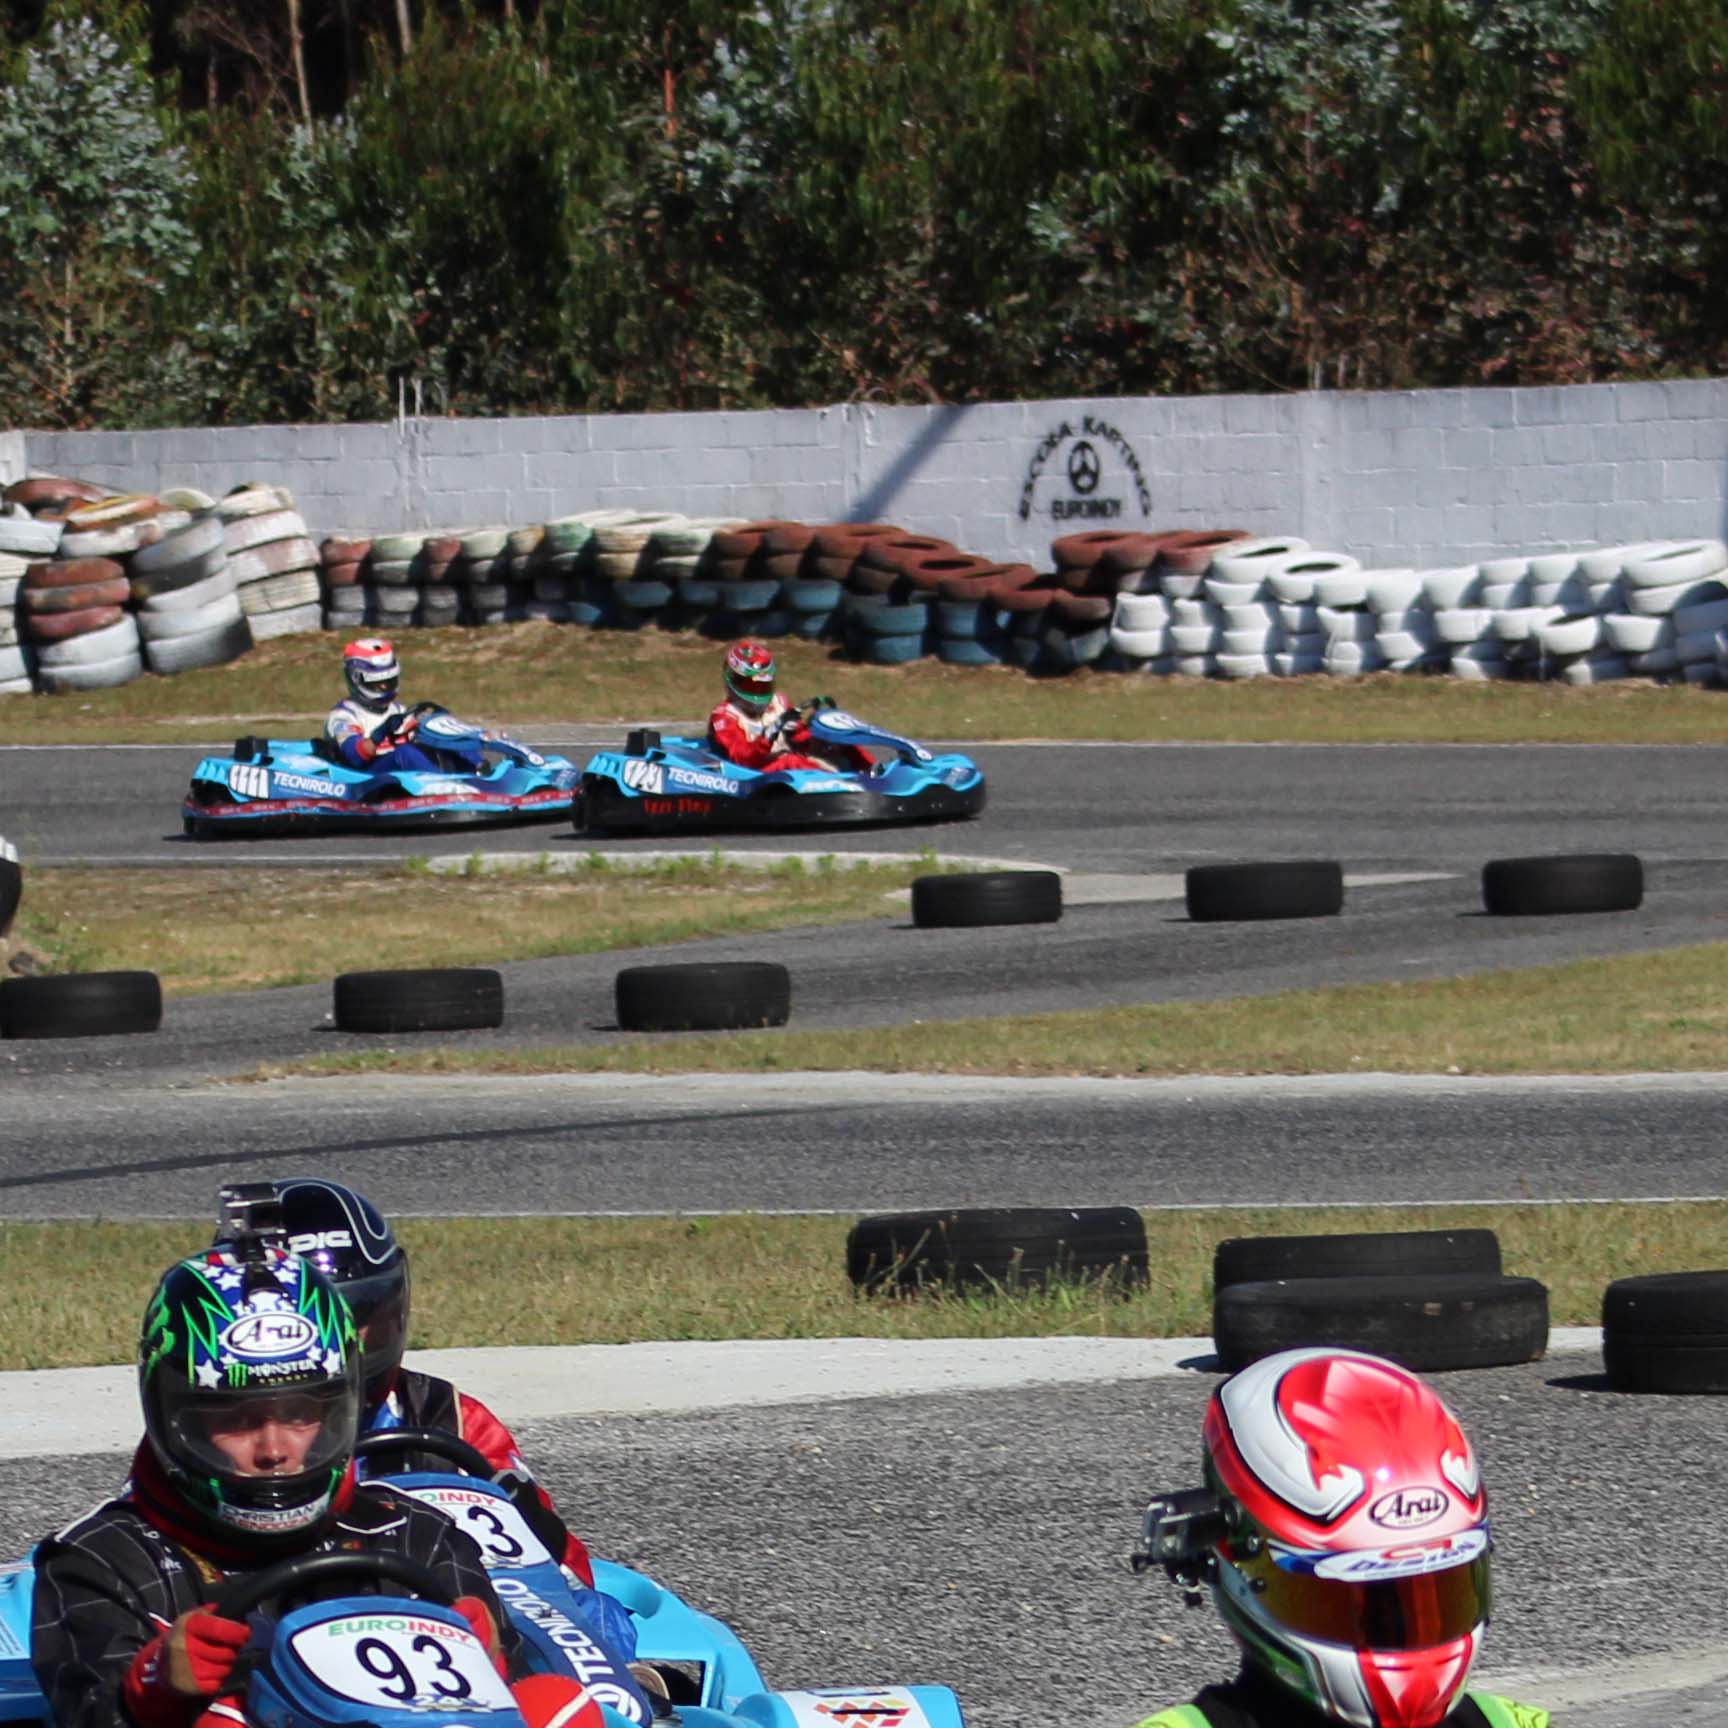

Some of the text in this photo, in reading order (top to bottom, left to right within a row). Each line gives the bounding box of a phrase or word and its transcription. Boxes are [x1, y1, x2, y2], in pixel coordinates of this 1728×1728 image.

[273, 772, 346, 797] TECNIROLO
[667, 766, 739, 794] TECNIROLO
[236, 1319, 302, 1344] Arai
[1376, 1491, 1442, 1520] Arai
[467, 1505, 523, 1558] 3
[328, 1618, 472, 1643] EUROINDY
[355, 1635, 472, 1701] 93
